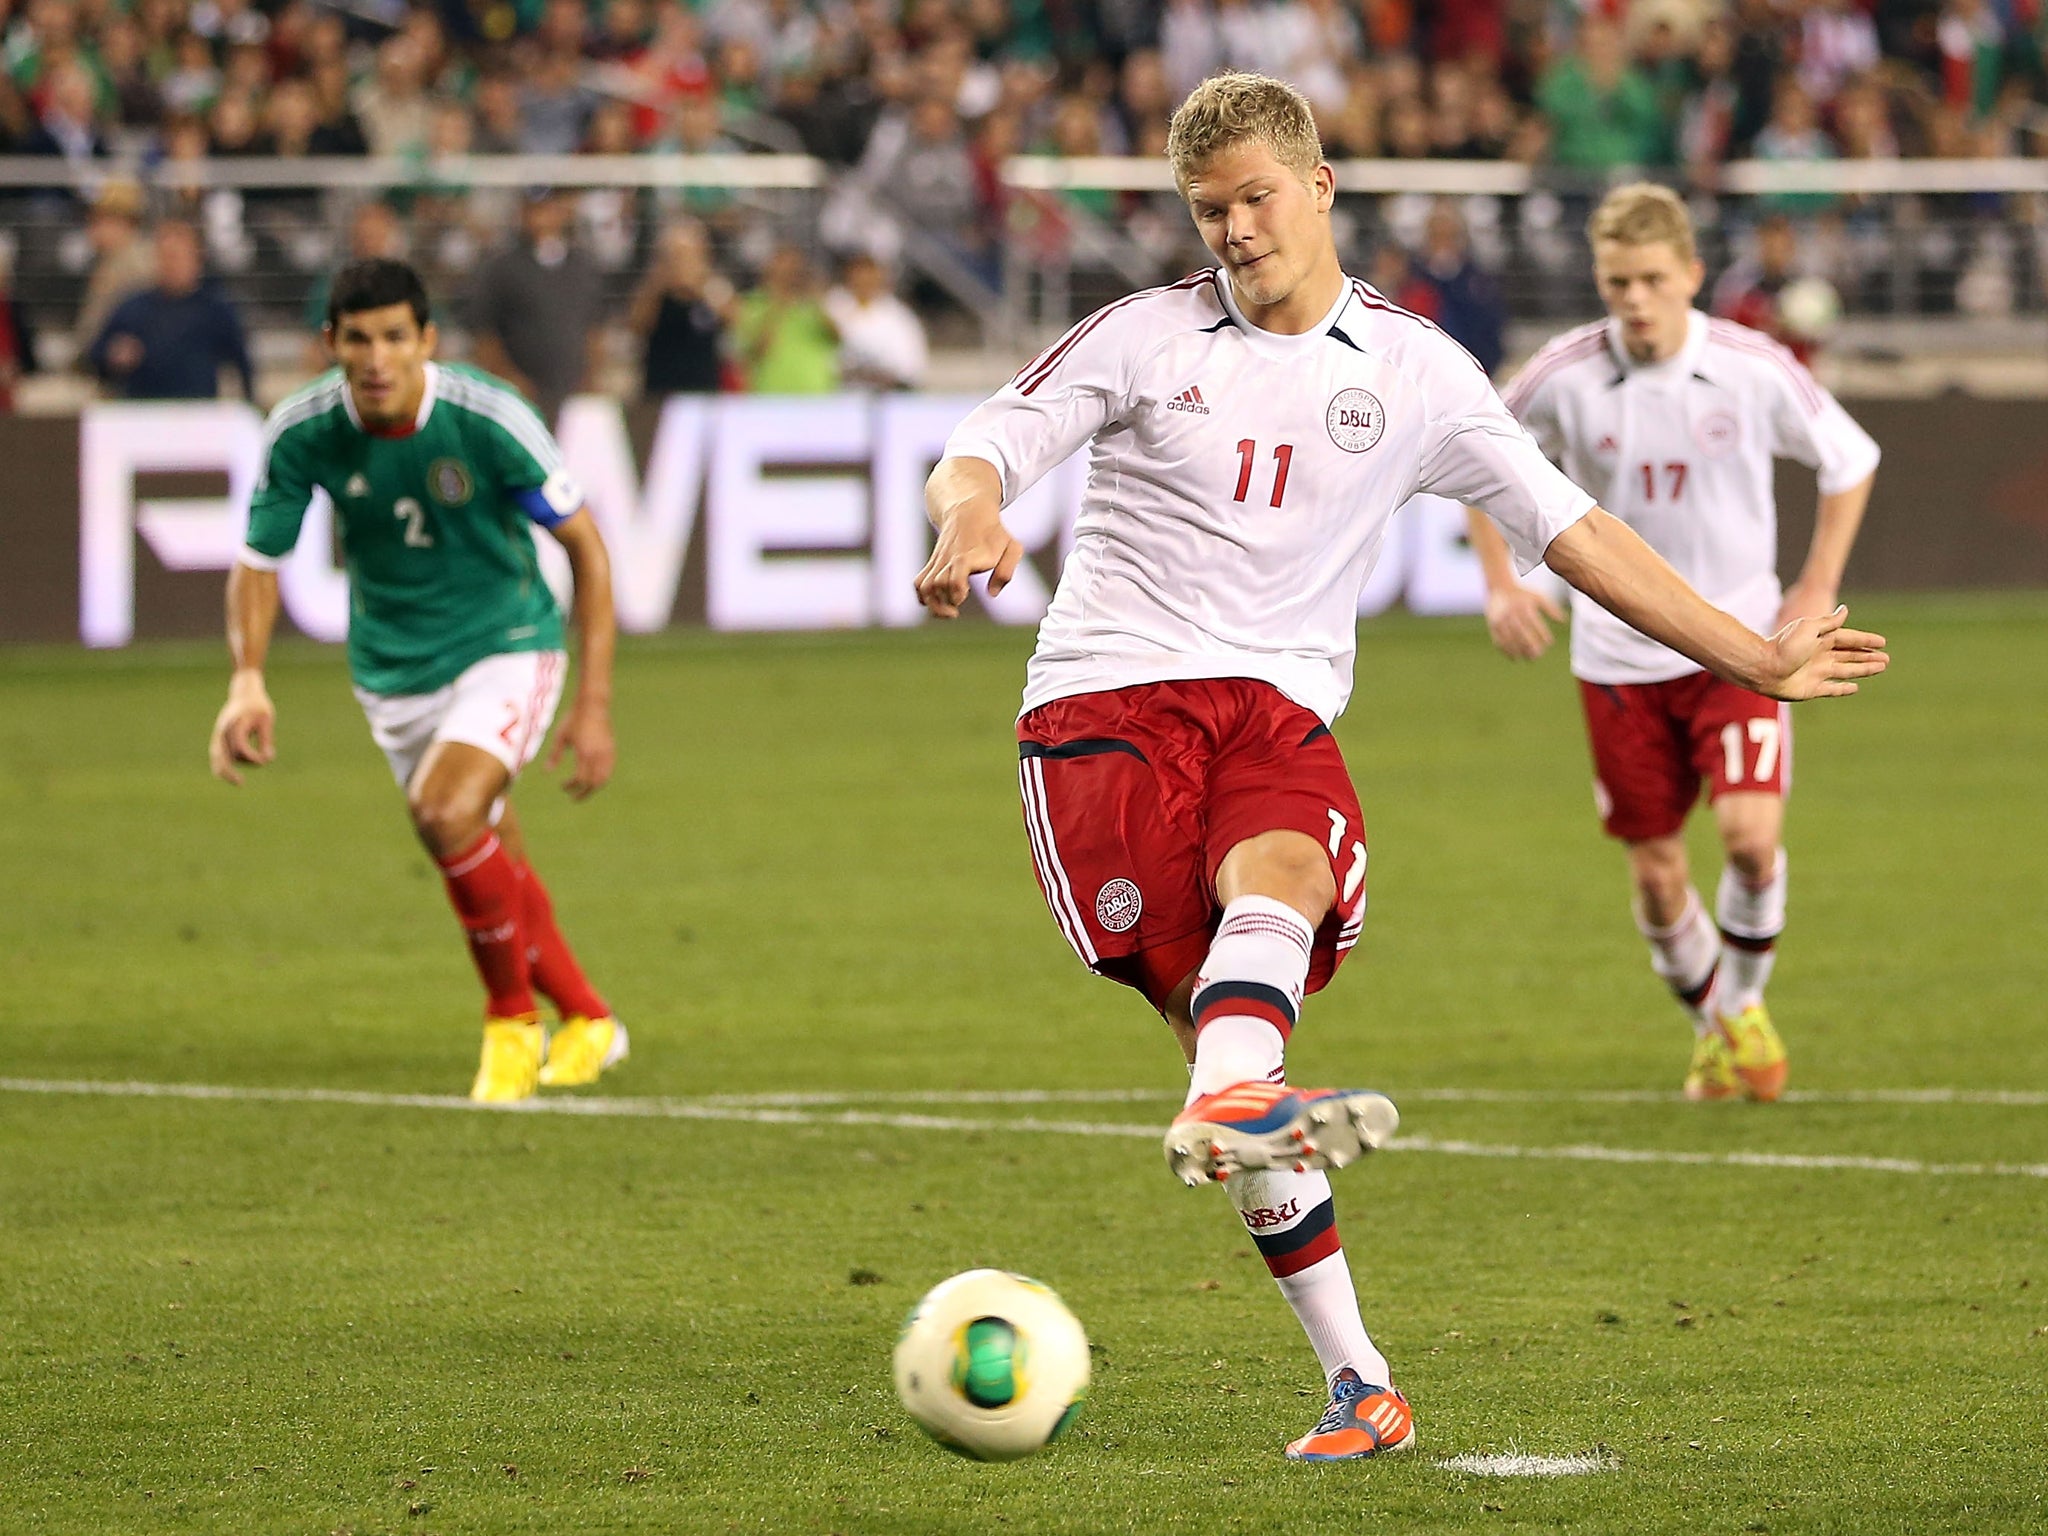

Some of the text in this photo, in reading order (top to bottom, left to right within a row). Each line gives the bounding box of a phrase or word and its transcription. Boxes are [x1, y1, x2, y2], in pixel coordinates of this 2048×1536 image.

[1166, 401, 1210, 415] adidas
[1339, 409, 1371, 429] DBU
[1233, 438, 1294, 508] 11
[1640, 461, 1688, 502] 17
[393, 498, 433, 548] 2
[498, 701, 521, 747] 2
[1720, 717, 1780, 784] 17
[1327, 807, 1368, 904] 11
[1104, 891, 1131, 917] DBU
